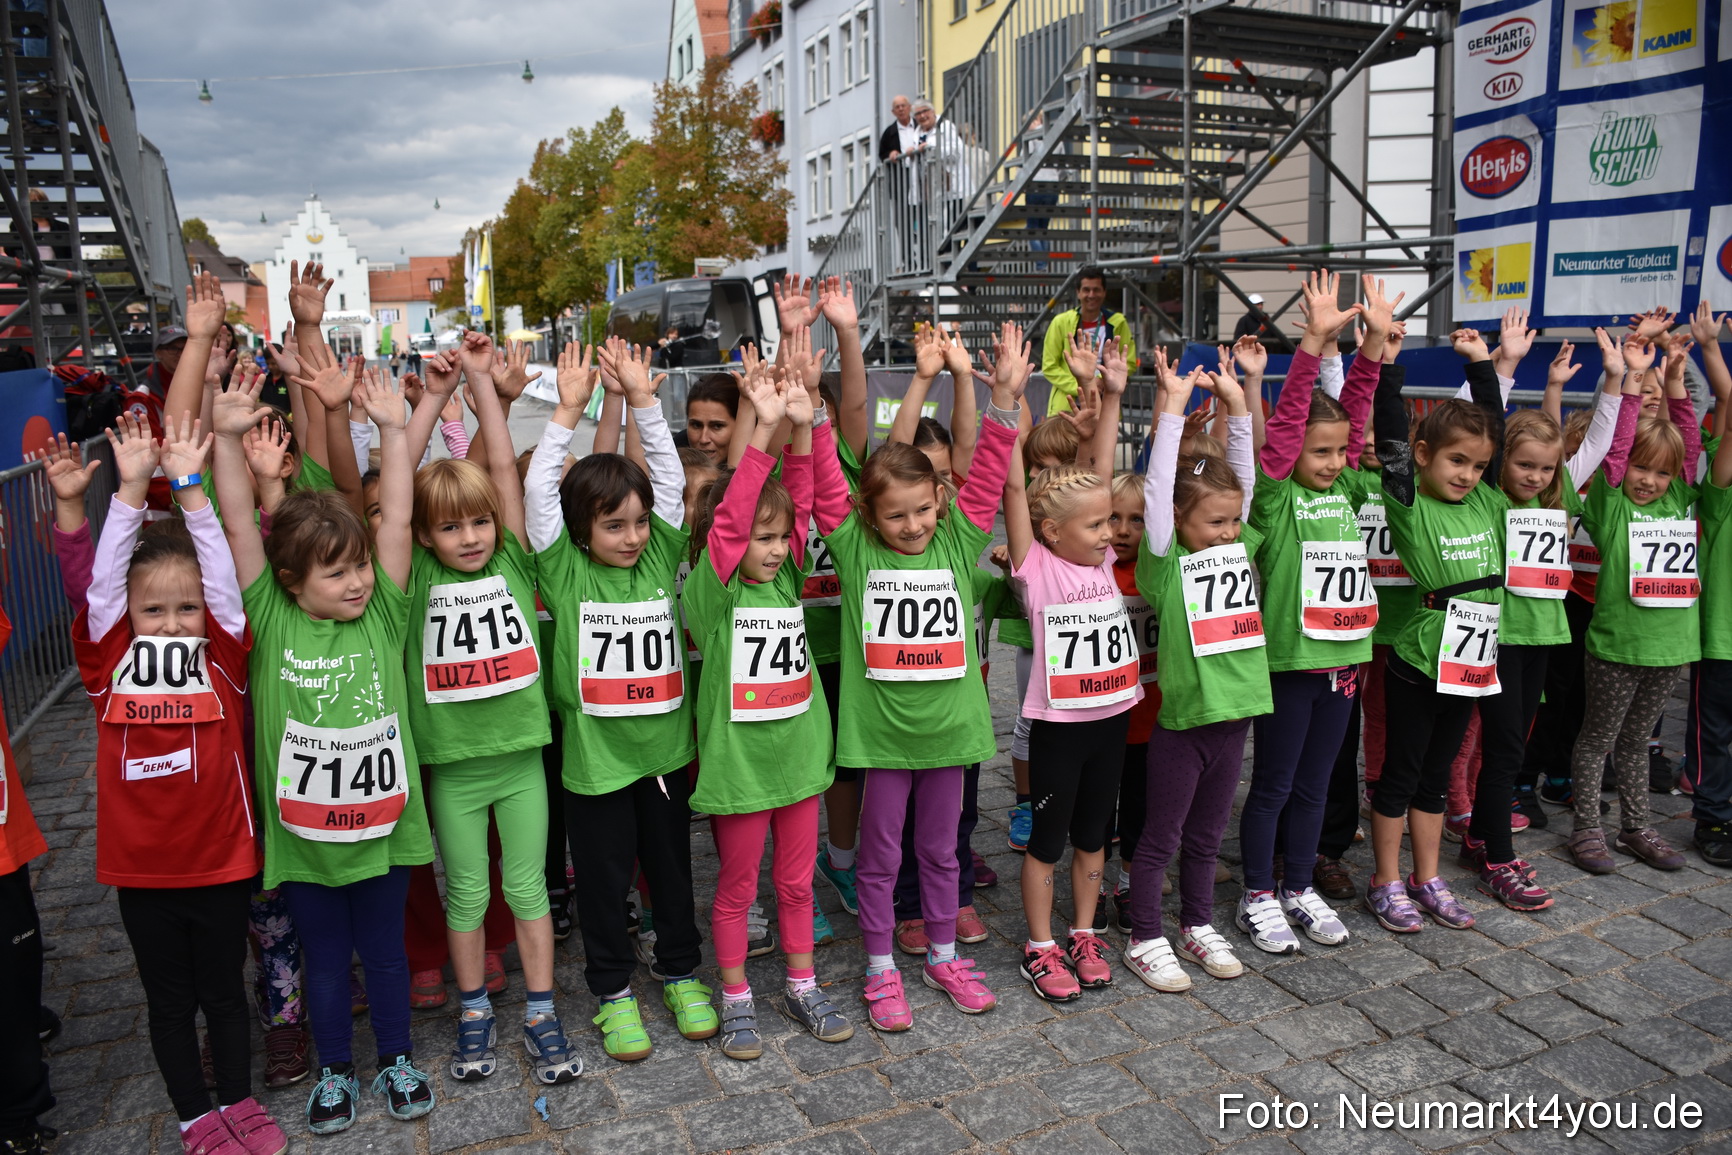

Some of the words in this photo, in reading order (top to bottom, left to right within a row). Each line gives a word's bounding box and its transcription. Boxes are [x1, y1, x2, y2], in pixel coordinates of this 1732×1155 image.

[1468, 26, 1525, 51] GERHART
[1643, 28, 1692, 53] KANN
[1492, 77, 1516, 96] KIA
[1593, 111, 1657, 152] RUND
[1468, 148, 1527, 183] Hervis
[1589, 146, 1663, 186] SCHAU
[1559, 254, 1625, 272] Neumarkter
[1627, 252, 1671, 270] Tagblatt
[1620, 276, 1638, 284] Hier
[1640, 274, 1658, 283] lebe
[1660, 273, 1677, 282] ich.
[1497, 281, 1526, 296] KANN
[1296, 507, 1344, 520] Stadtlauf
[1509, 517, 1543, 527] PARTL
[1632, 530, 1667, 538] PARTL
[1305, 551, 1342, 561] PARTL
[1518, 530, 1570, 565] 721
[1183, 557, 1221, 574] PARTL
[867, 581, 900, 592] PARTL
[904, 581, 950, 592] Neumarkt
[1314, 566, 1373, 603] 707
[1545, 573, 1559, 586] Ida
[1635, 582, 1687, 595] Felicitas
[454, 588, 505, 607] Neumarkt
[583, 613, 619, 625] PARTL
[735, 619, 774, 630] PARTL
[873, 596, 958, 639] 7029
[1048, 614, 1086, 626] PARTL
[1232, 617, 1259, 635] Julia
[1333, 612, 1367, 629] Sophia
[430, 603, 523, 658] 7415
[591, 626, 675, 672] 7101
[744, 631, 810, 677] 743
[1058, 620, 1133, 670] 7181
[895, 649, 943, 665] Anouk
[435, 656, 511, 689] LUZIE
[627, 684, 655, 700] Eva
[1079, 674, 1127, 694] Madlen
[765, 687, 806, 706] Emma
[125, 700, 193, 724] Sophia
[285, 731, 327, 750] PARTL
[330, 733, 385, 752] Neumarkt
[142, 760, 173, 773] DEHN
[293, 747, 396, 799] 7140
[325, 810, 366, 830] Anja
